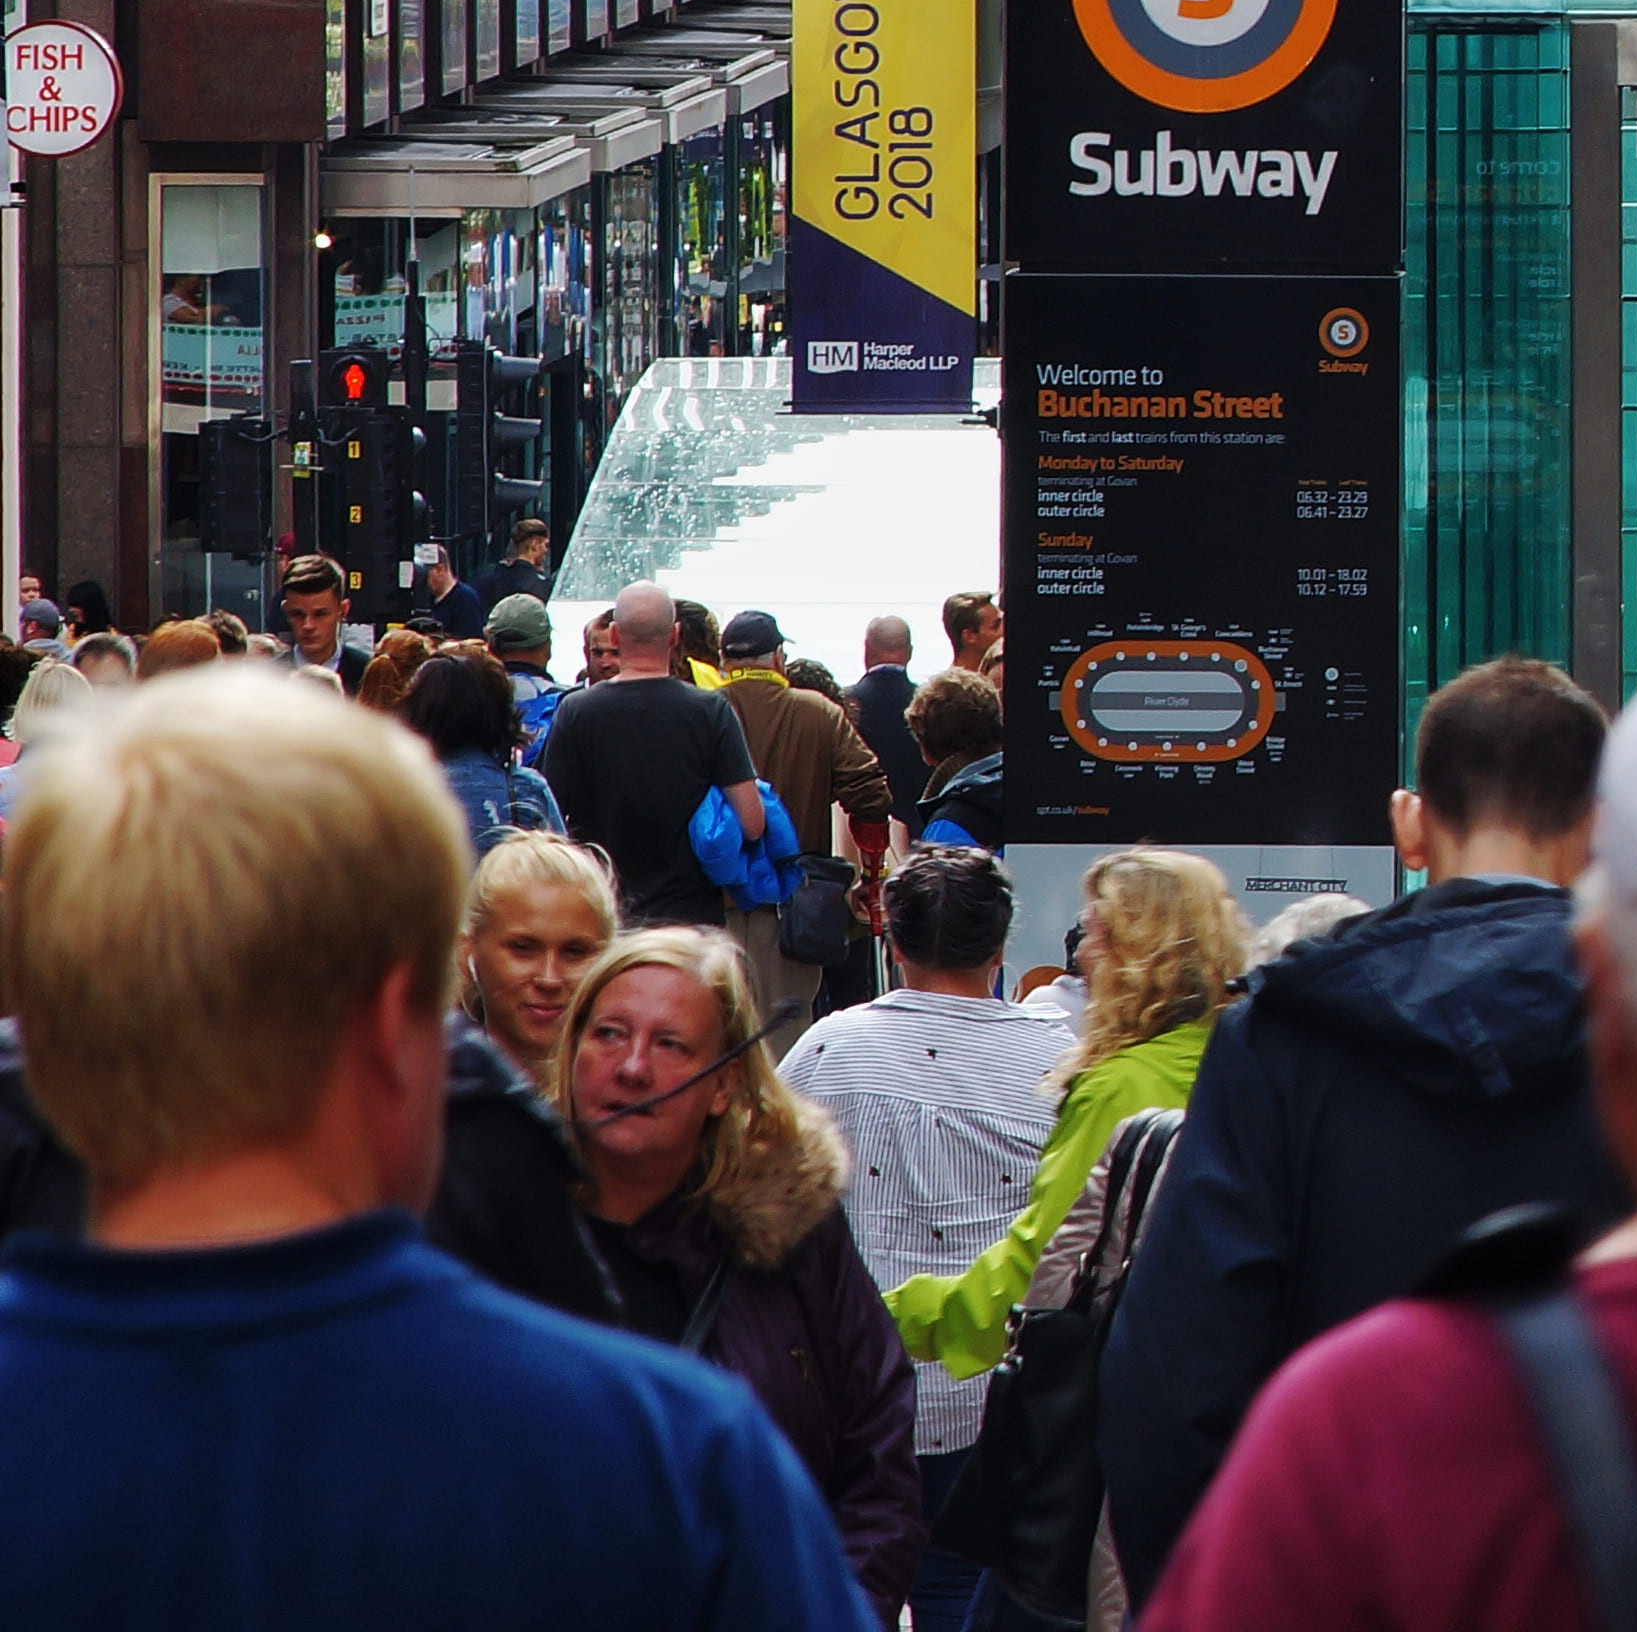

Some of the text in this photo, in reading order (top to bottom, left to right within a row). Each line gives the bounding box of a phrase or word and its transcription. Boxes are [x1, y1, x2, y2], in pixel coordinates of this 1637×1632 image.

[16, 44, 84, 71] FISH
[39, 76, 62, 102] &
[7, 106, 98, 132] CHIPS
[888, 106, 934, 221] 2018
[1068, 130, 1338, 215] Subway
[812, 345, 854, 366] HM
[863, 342, 914, 358] Harper
[863, 355, 959, 370] Macleod LLP
[1318, 359, 1369, 376] Subway
[1036, 363, 1164, 385] Welcome to
[1038, 388, 1284, 418] Buchanan Street
[1062, 430, 1087, 443] first
[1111, 431, 1134, 443] last
[1170, 430, 1198, 444] from
[1200, 431, 1221, 444] this
[1223, 431, 1264, 444] station
[1038, 455, 1184, 474] Monday to Saturday
[1037, 489, 1104, 502] inner circle
[1037, 504, 1105, 517] outer circle
[1038, 531, 1094, 550] Sunday
[1037, 566, 1103, 579] inner circle
[1037, 581, 1105, 594] outer circle
